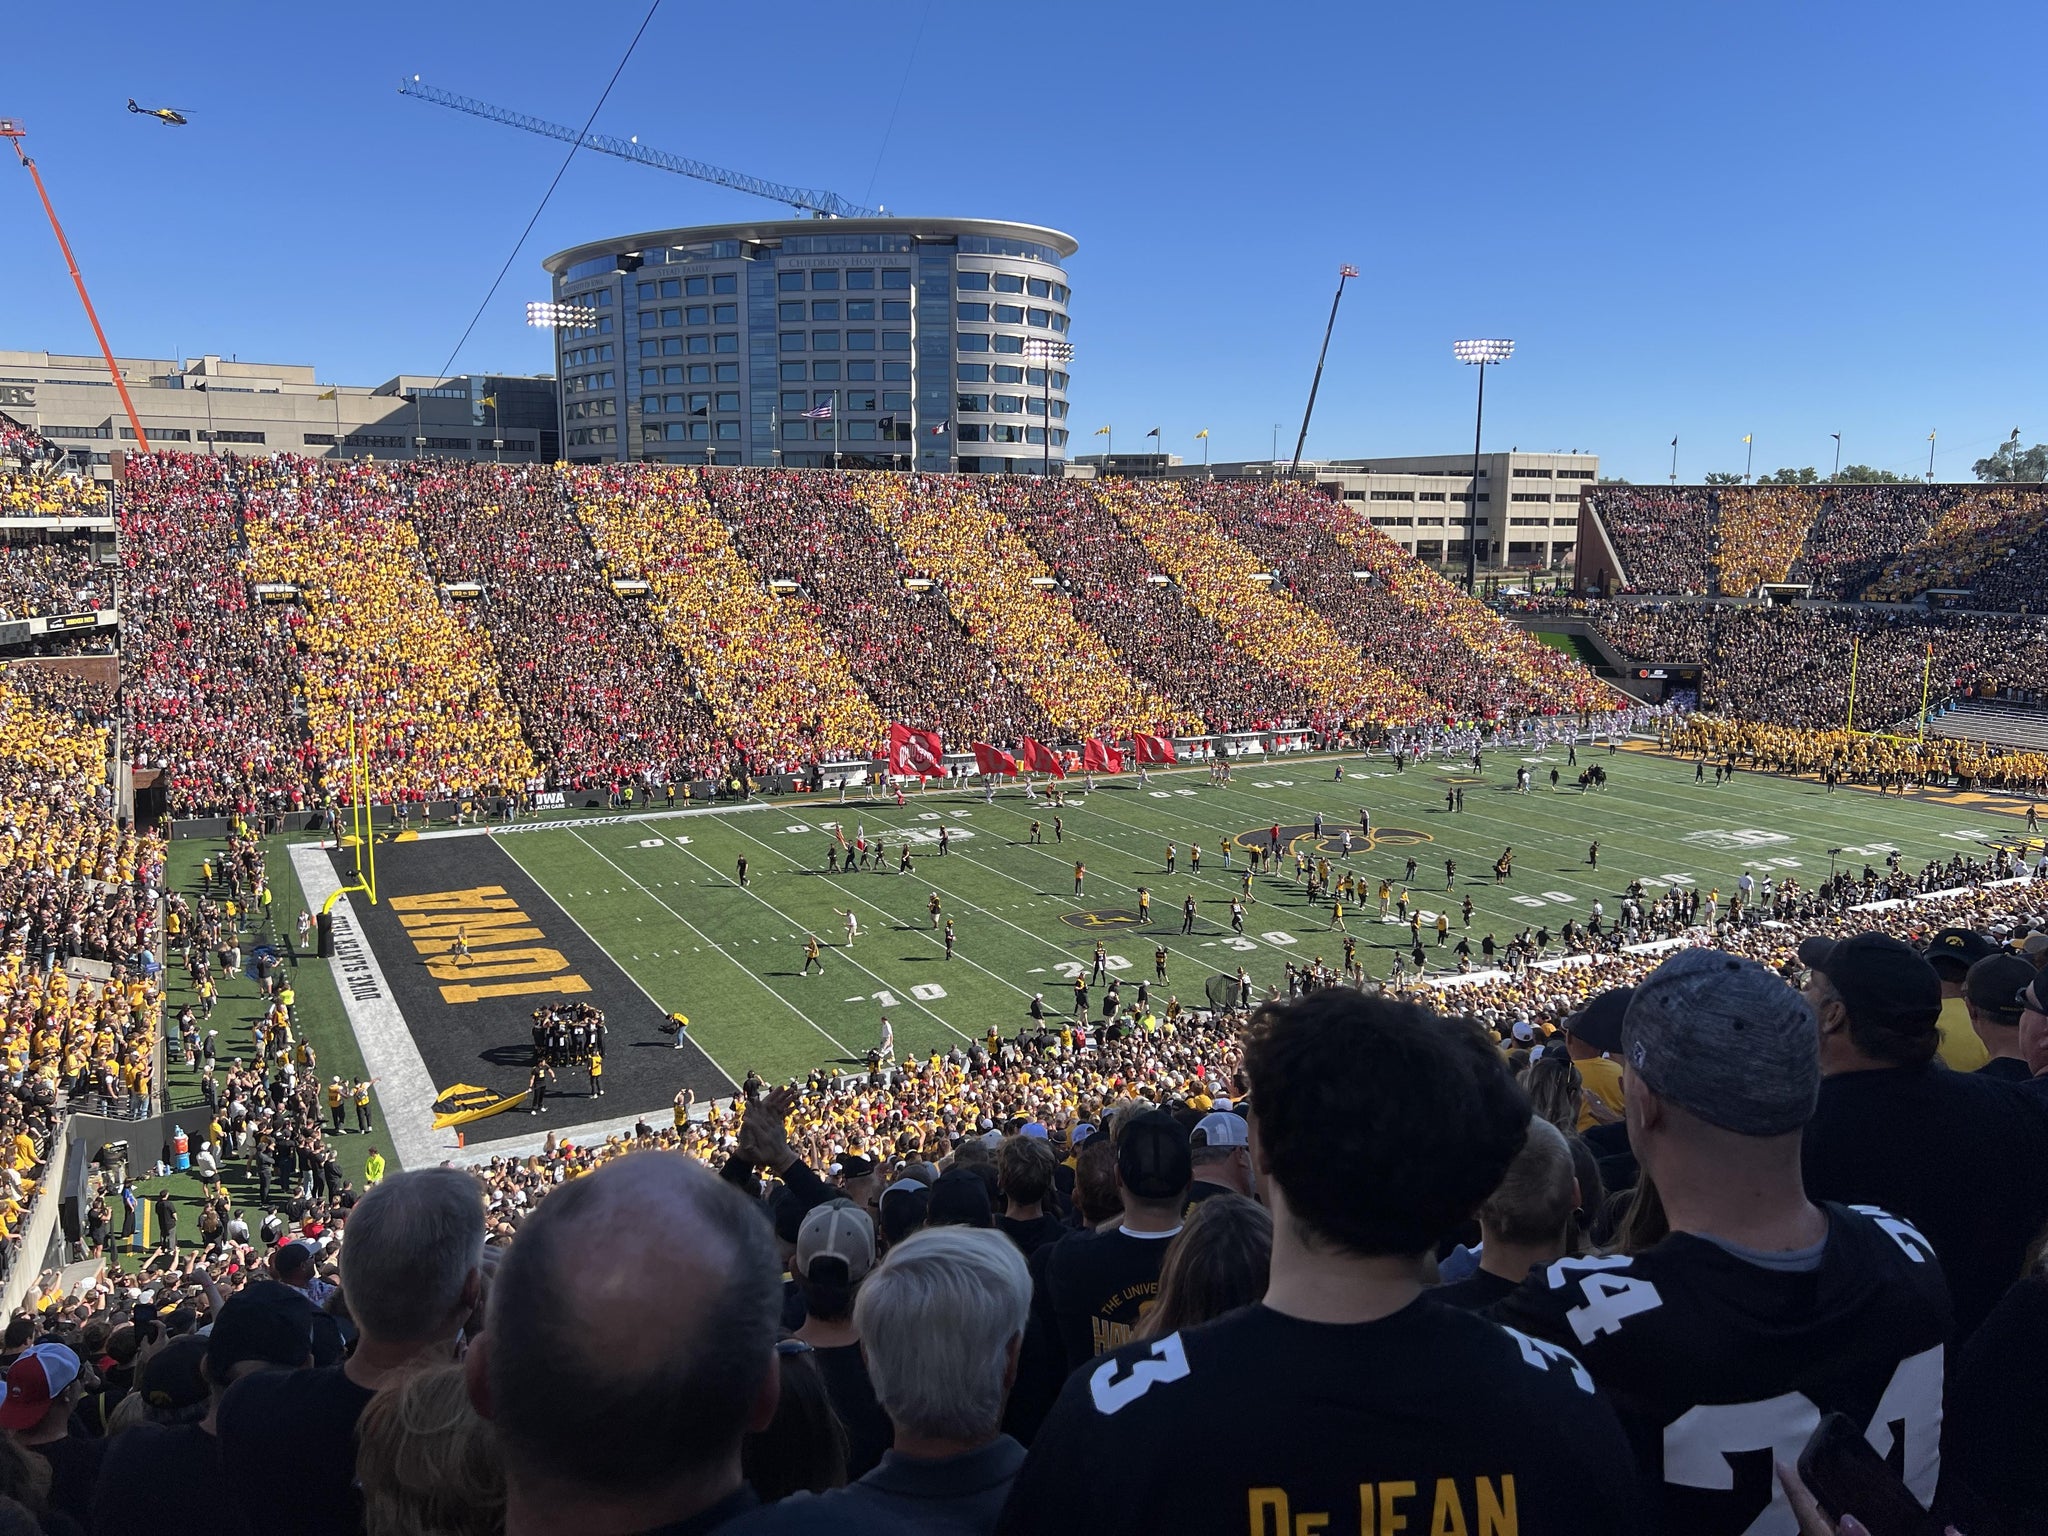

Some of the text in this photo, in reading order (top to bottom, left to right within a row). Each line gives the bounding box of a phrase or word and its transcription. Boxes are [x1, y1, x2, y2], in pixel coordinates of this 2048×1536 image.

[851, 256, 901, 265] HOSPITAL
[494, 816, 627, 833] PROGRESSIVE
[1508, 890, 1578, 908] 50
[388, 885, 592, 1004] IOWA
[1220, 931, 1299, 951] 30
[334, 938, 370, 973] SLATER
[1053, 955, 1134, 978] 20
[346, 974, 382, 1002] DUKE
[871, 983, 948, 1008] 10
[1101, 1282, 1159, 1315] THE UNIVE
[1547, 1254, 1664, 1346] 24
[1088, 1331, 1191, 1415] 3
